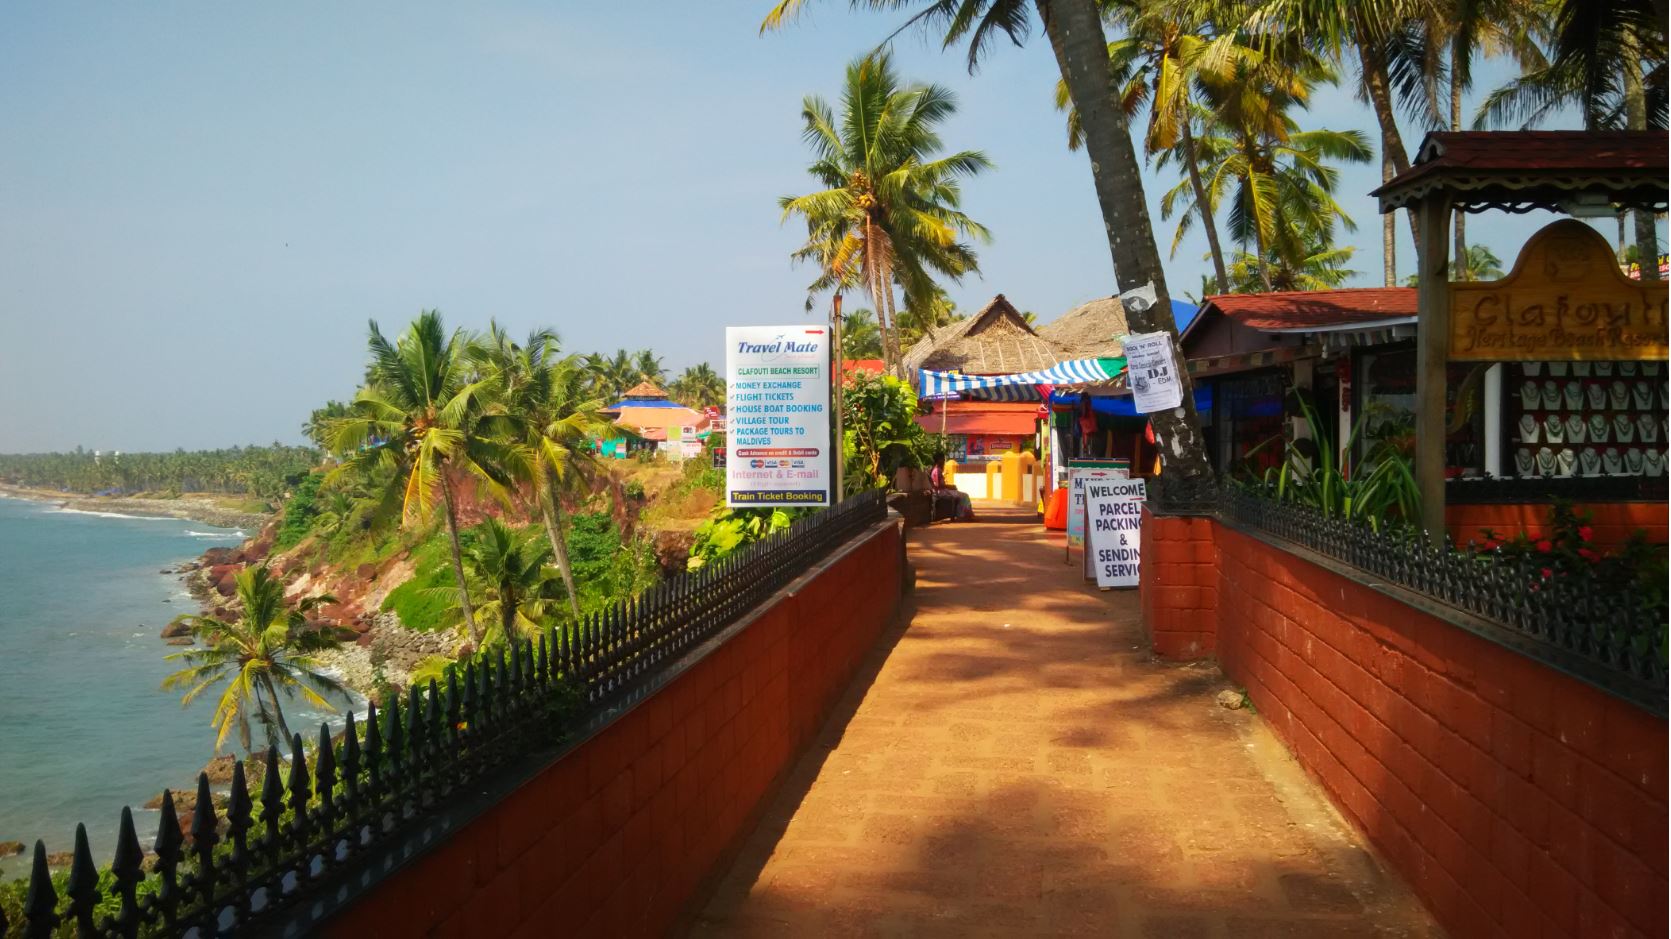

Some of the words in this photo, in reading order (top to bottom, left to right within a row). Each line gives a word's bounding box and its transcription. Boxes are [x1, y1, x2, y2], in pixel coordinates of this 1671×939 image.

[738, 342, 781, 353] Travel
[784, 341, 818, 352] Mate
[1147, 366, 1168, 379] DJ
[736, 393, 762, 401] FLIGHT
[736, 405, 762, 413] HOUSE
[786, 404, 822, 412] BOOKING
[736, 417, 766, 425] VILLAGE
[770, 427, 793, 435] TOURS
[732, 470, 773, 478] Internet
[776, 470, 783, 478] &
[787, 470, 819, 478] E-mail
[1089, 483, 1145, 498] WELCOME
[733, 492, 755, 500] Train
[757, 492, 784, 500] Ticket
[786, 492, 822, 501] Booking
[1099, 503, 1140, 516] PARCEL
[1120, 534, 1128, 545] &
